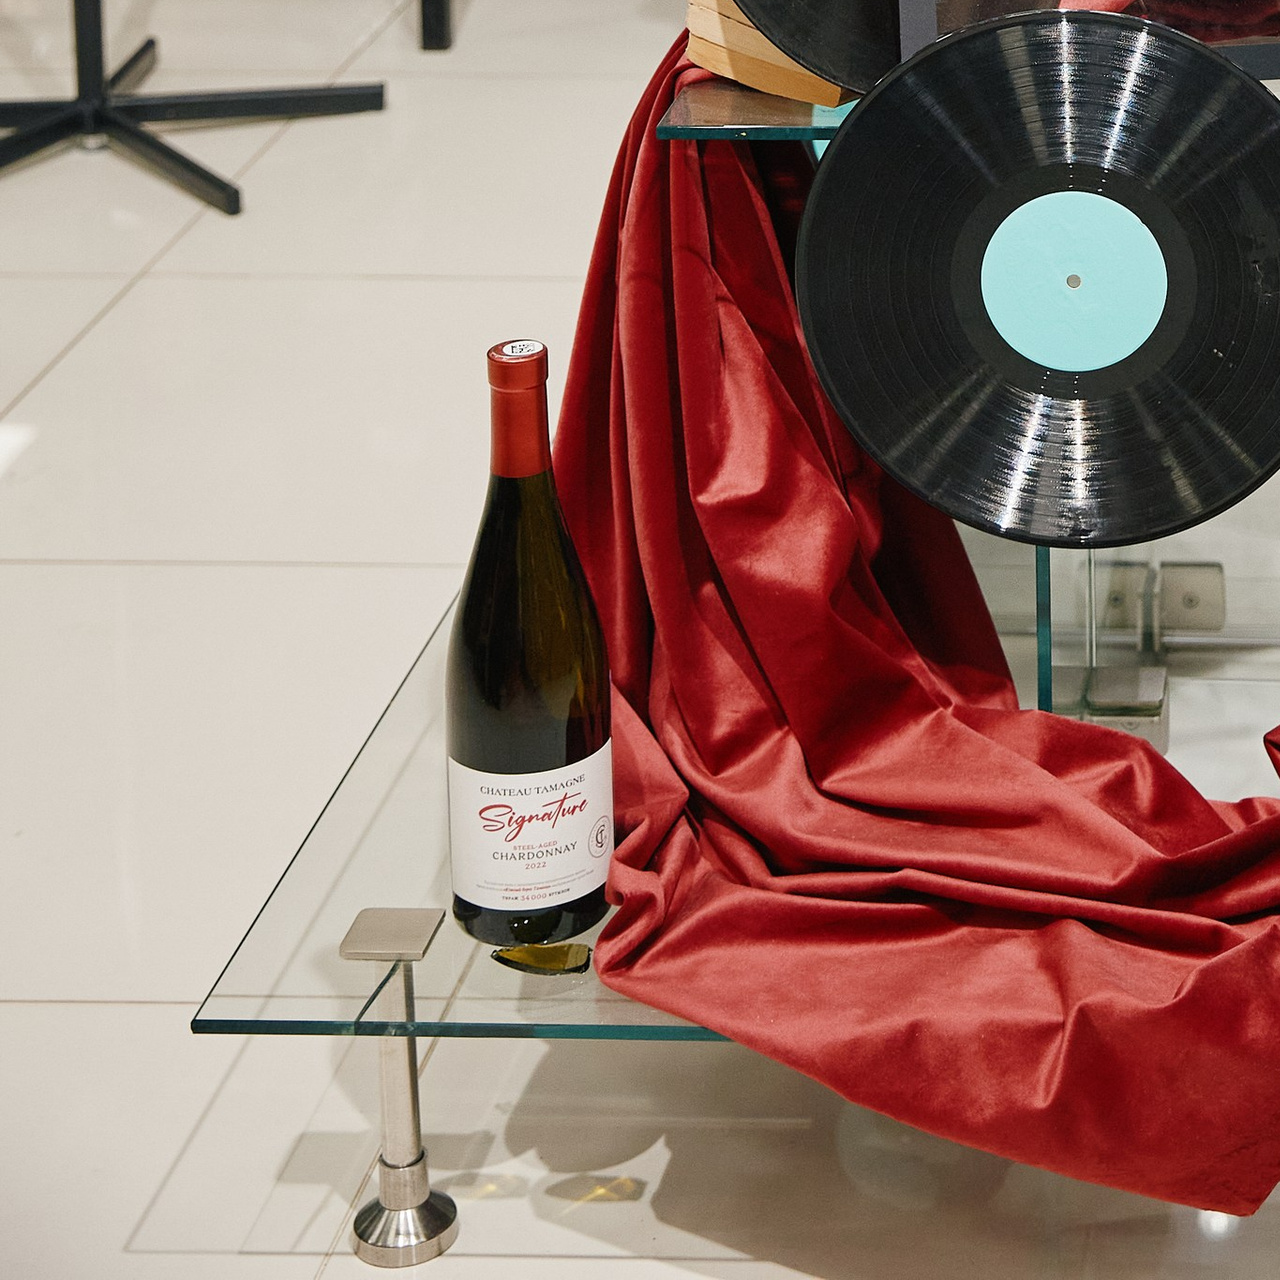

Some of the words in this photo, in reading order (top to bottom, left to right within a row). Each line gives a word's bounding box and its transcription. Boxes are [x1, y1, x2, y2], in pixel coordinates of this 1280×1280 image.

[480, 785, 532, 797] CHATEAU
[534, 773, 586, 795] TAMAGNE
[478, 792, 588, 842] Signature
[492, 841, 578, 861] CHARDONNAY
[525, 861, 547, 870] 2022
